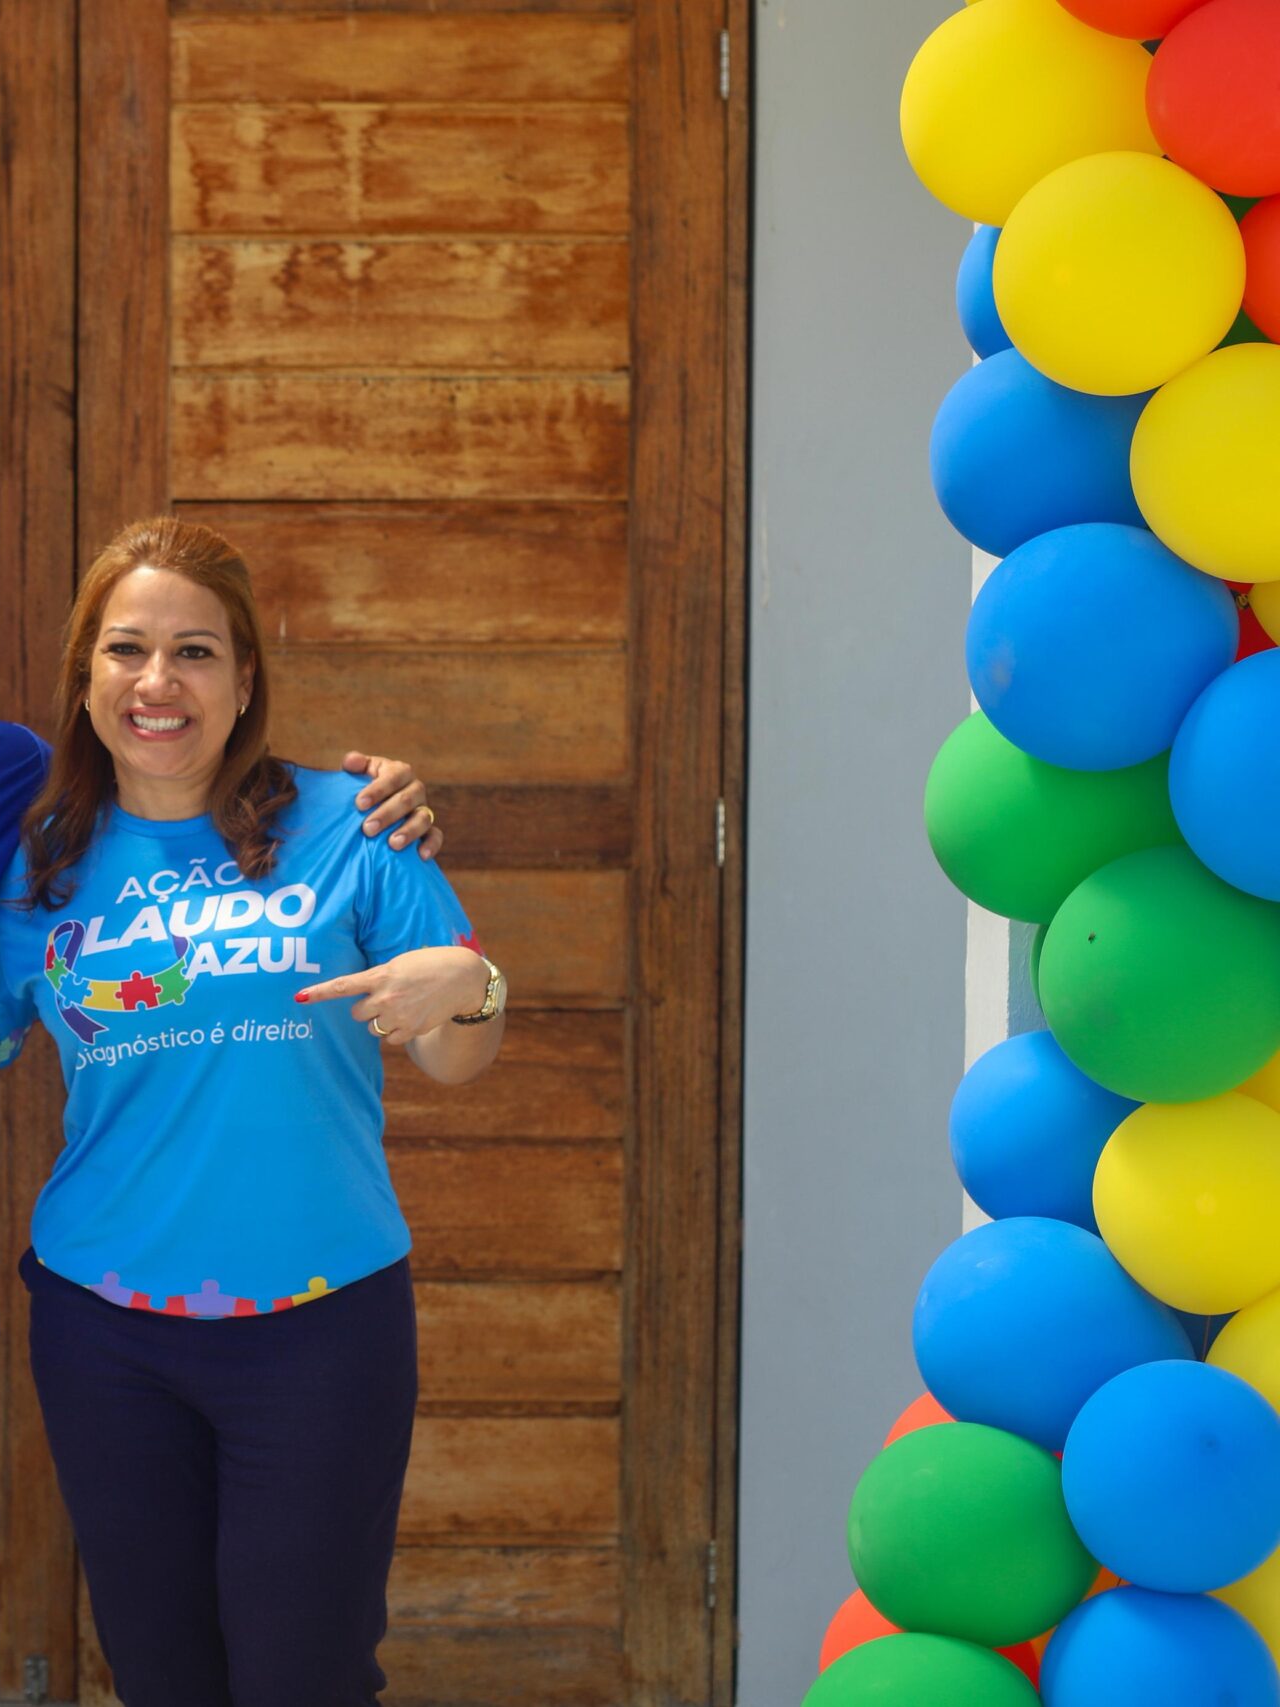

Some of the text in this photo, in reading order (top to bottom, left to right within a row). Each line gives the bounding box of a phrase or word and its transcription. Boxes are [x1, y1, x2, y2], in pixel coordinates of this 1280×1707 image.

[115, 857, 245, 905] AÇÃO
[81, 883, 317, 956] LAUDO
[184, 936, 321, 981] AZUL
[210, 1022, 225, 1044] é
[232, 1018, 314, 1042] direito!
